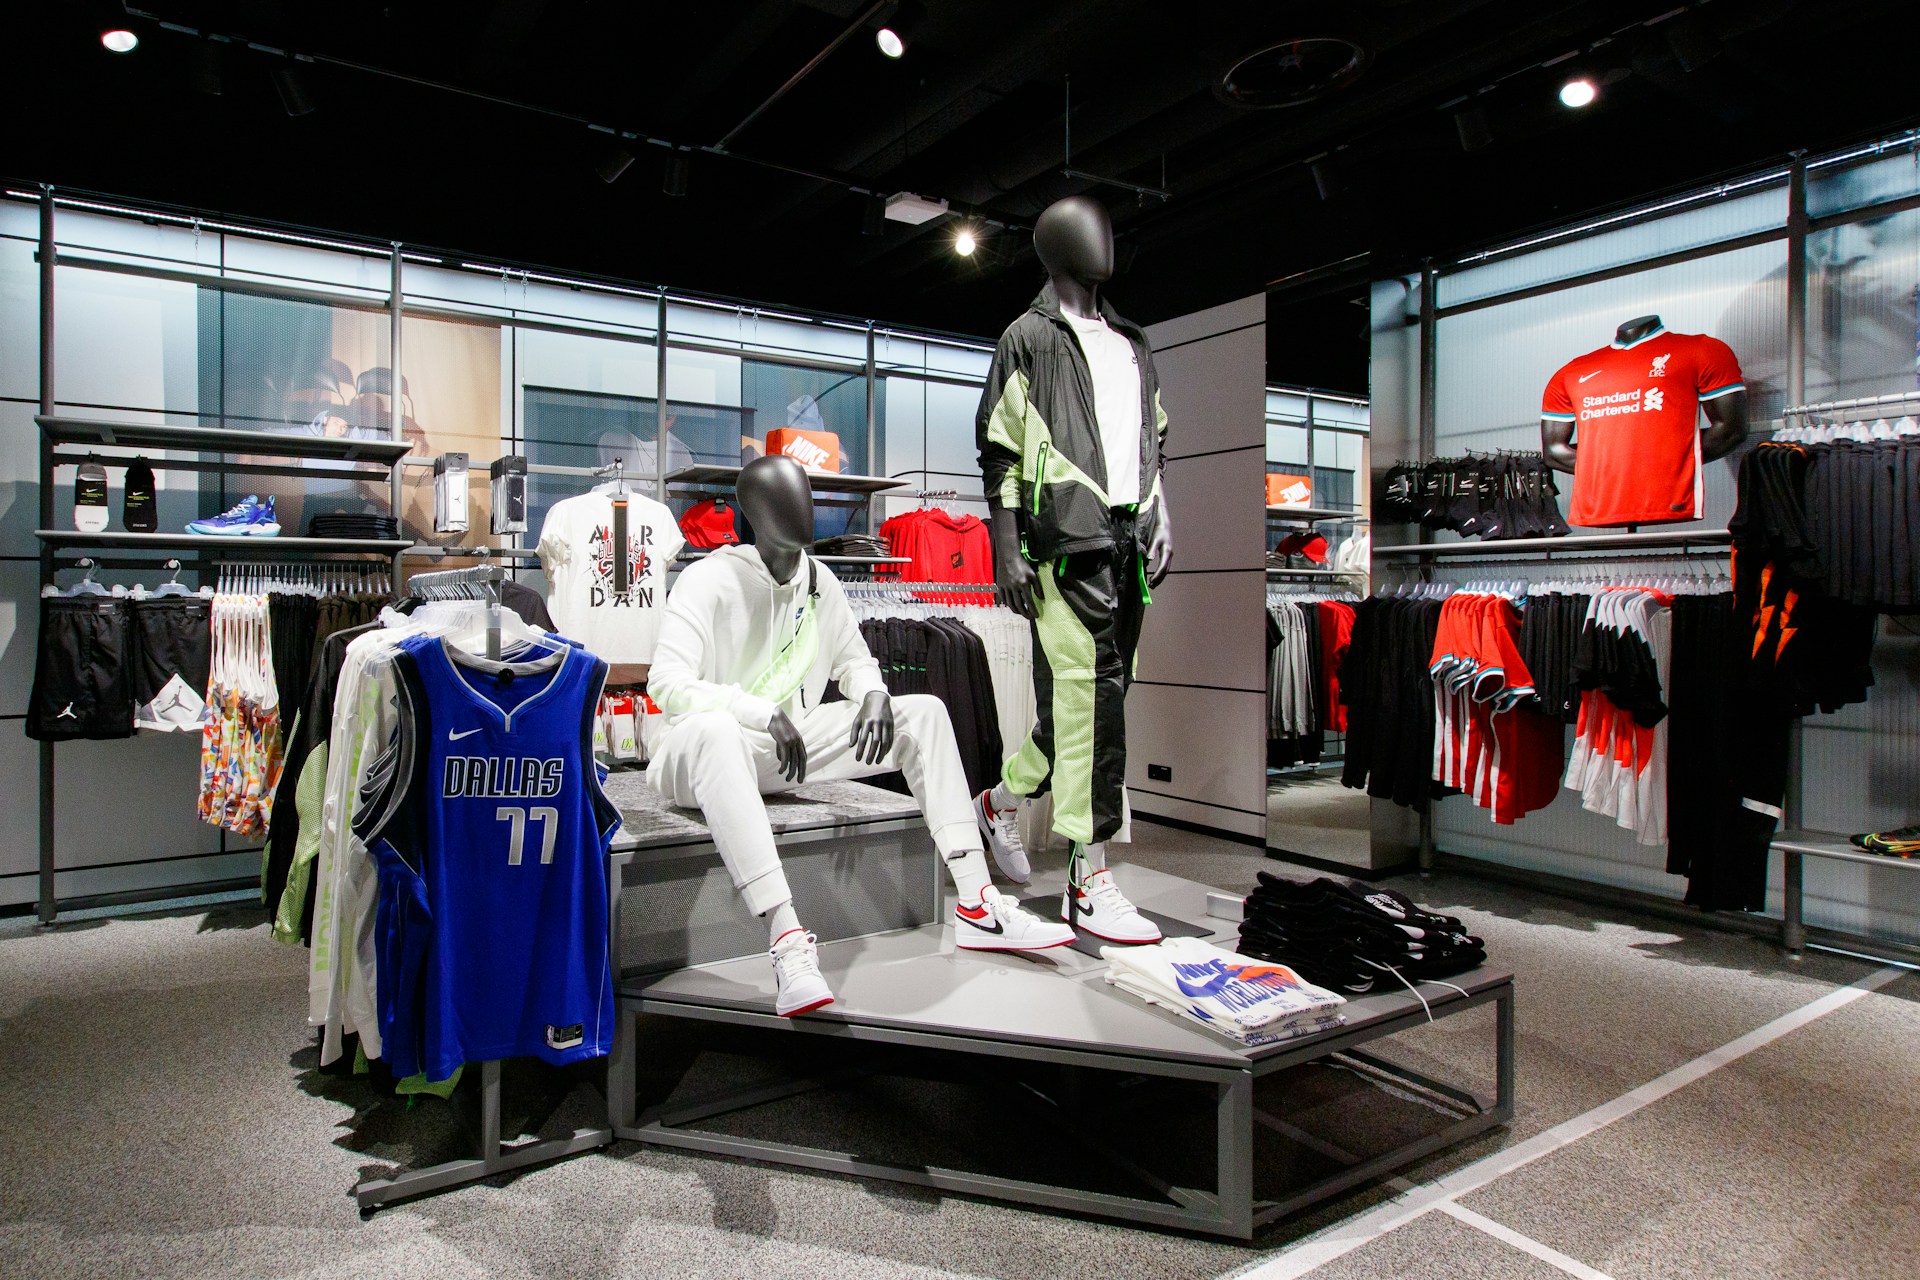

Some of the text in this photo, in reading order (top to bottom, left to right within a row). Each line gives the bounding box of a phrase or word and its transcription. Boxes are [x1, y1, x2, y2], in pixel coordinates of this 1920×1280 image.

[1580, 401, 1640, 421] Chartered
[1582, 388, 1641, 408] Standard
[785, 435, 831, 467] NIKE
[442, 755, 565, 799] DALLAS
[495, 806, 559, 866] 77
[1171, 958, 1228, 981] NIKE
